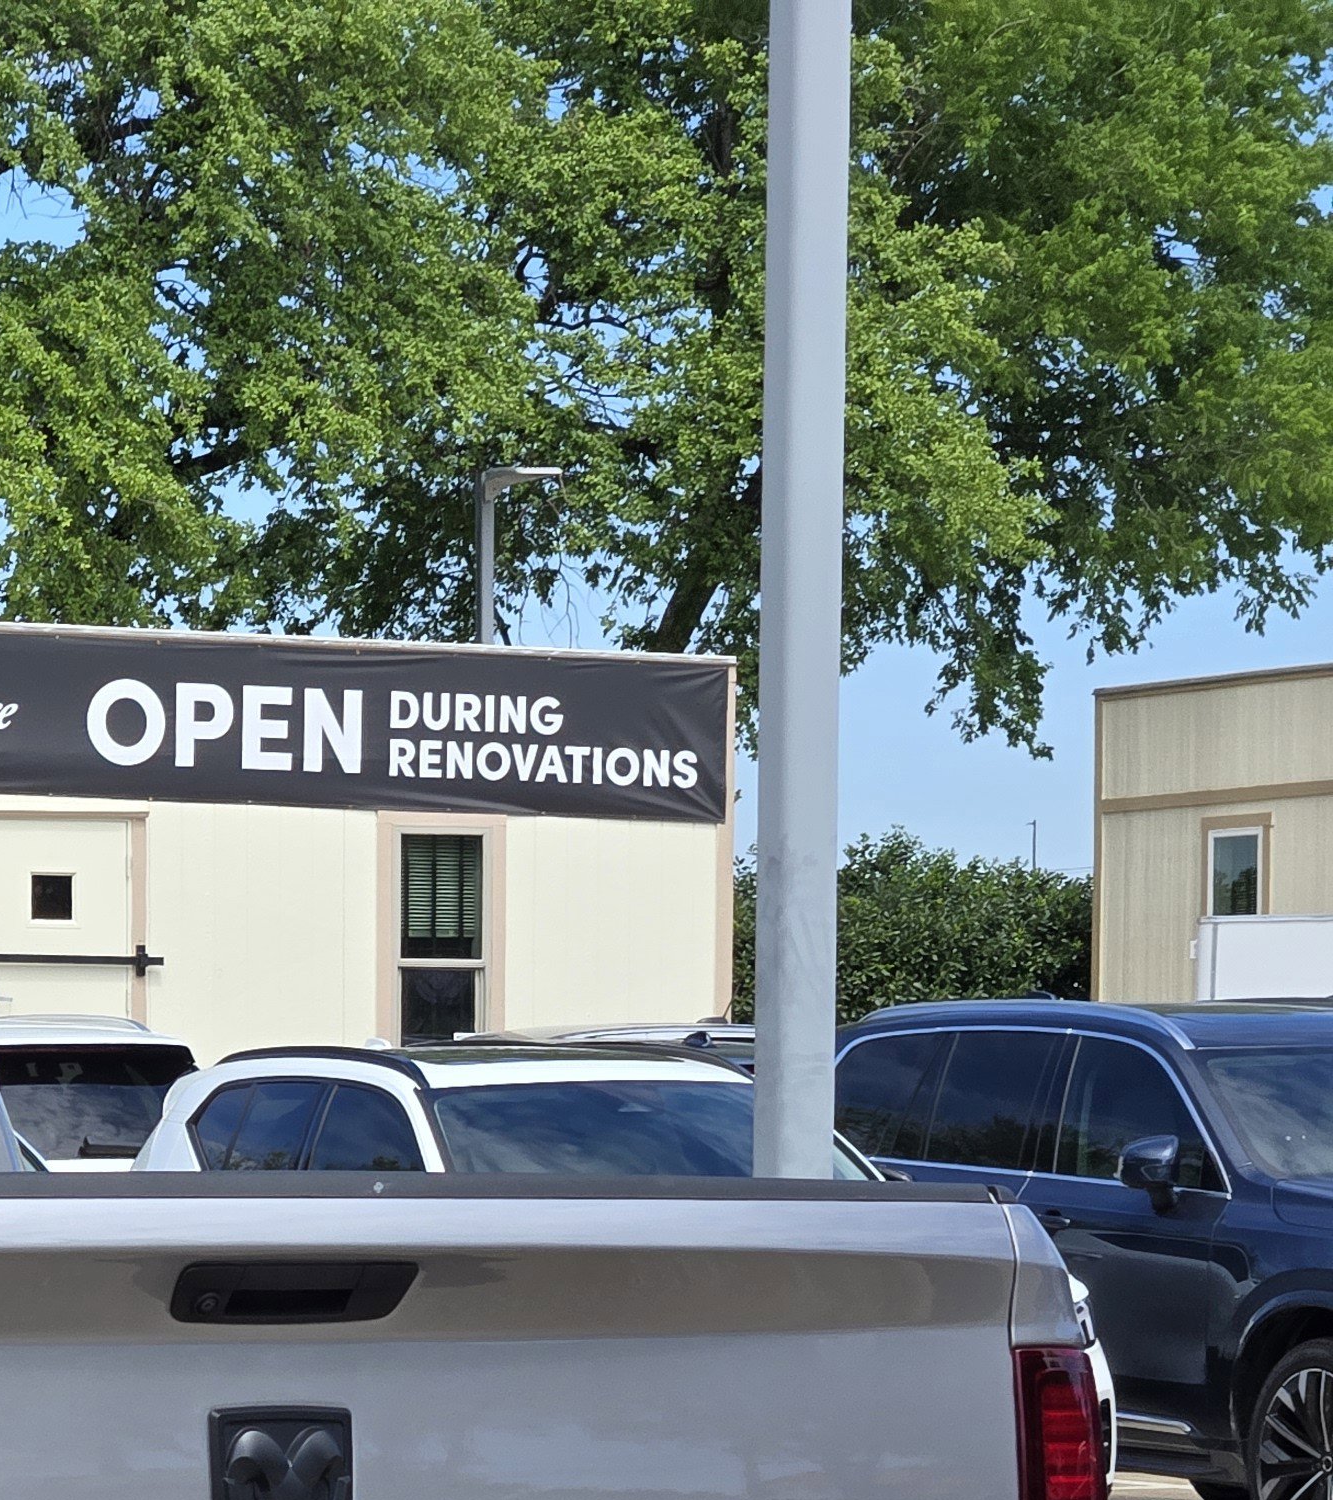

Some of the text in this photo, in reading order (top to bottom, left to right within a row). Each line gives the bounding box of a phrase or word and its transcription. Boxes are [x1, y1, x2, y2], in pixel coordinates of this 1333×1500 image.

[87, 678, 364, 774] OPEN
[389, 690, 564, 735] DURING
[388, 738, 698, 789] RENOVATIONS
